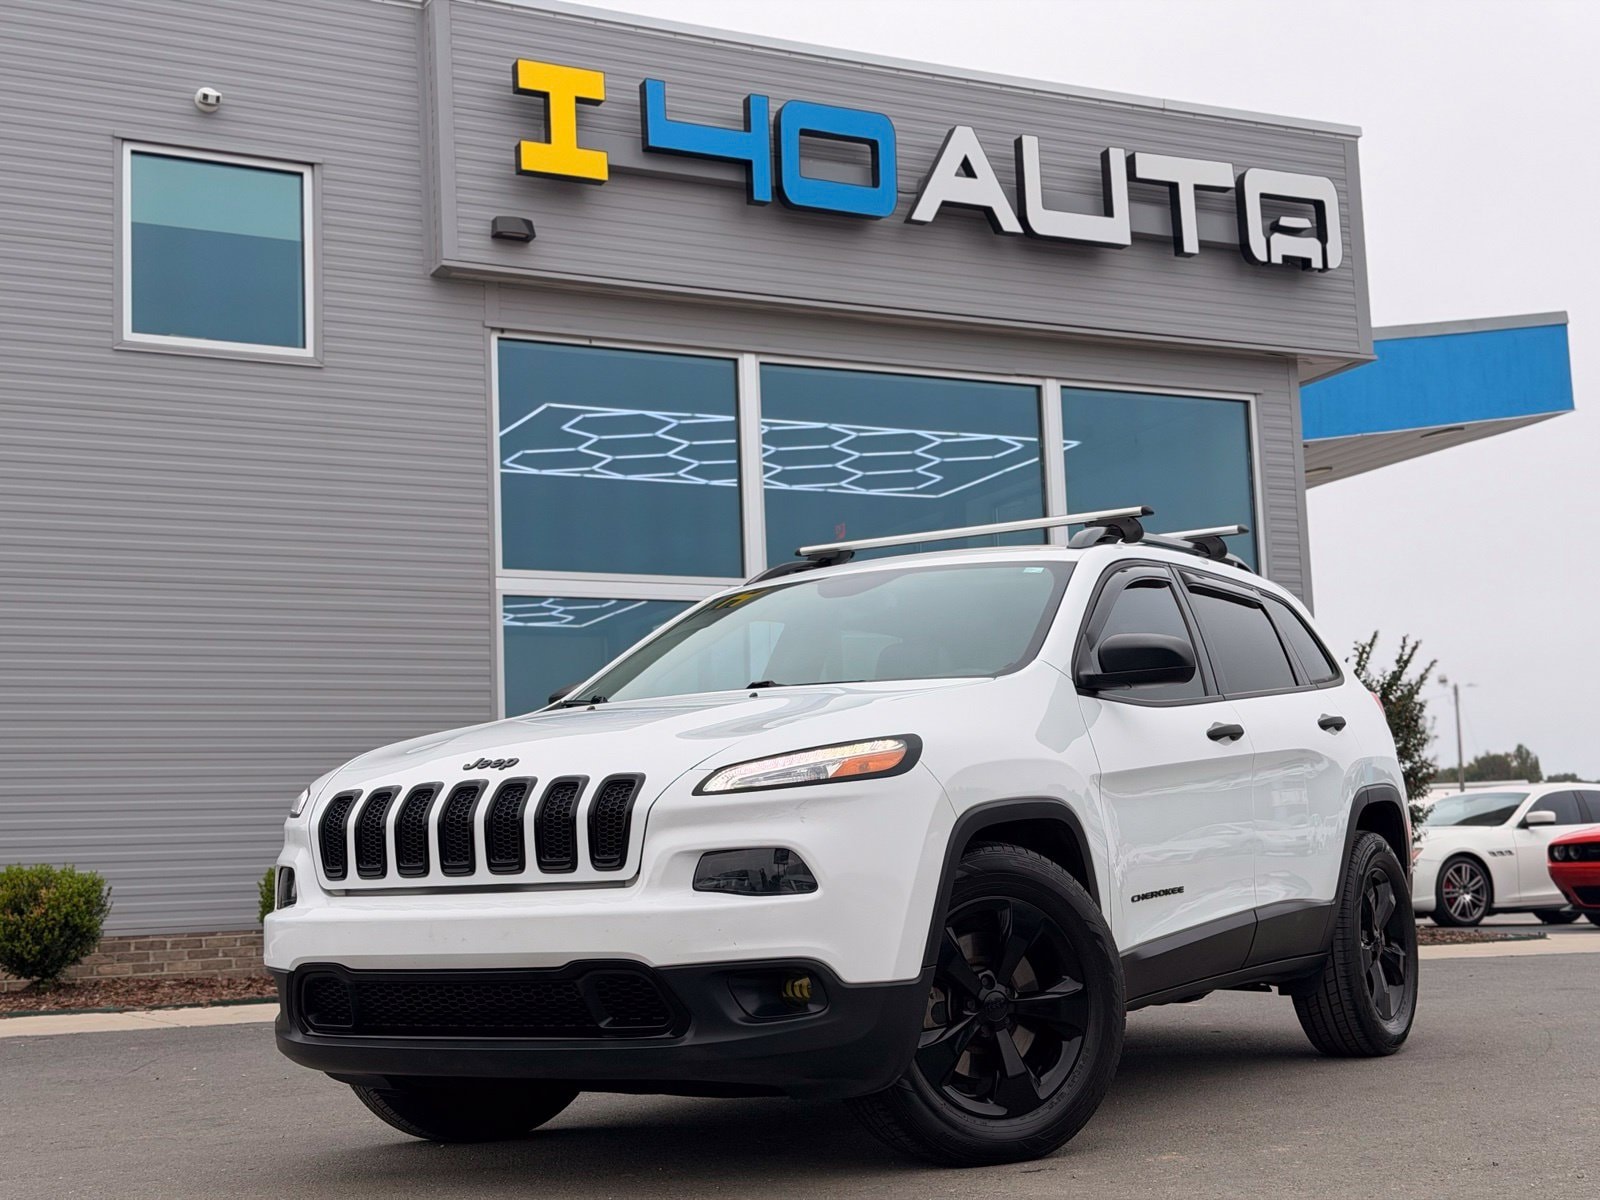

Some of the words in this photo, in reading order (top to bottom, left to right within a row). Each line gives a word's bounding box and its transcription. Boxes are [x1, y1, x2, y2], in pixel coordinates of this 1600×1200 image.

[640, 78, 899, 219] 40
[906, 125, 1343, 272] AUTO
[462, 757, 520, 771] Jeep
[1130, 885, 1185, 903] CHEROKEE
